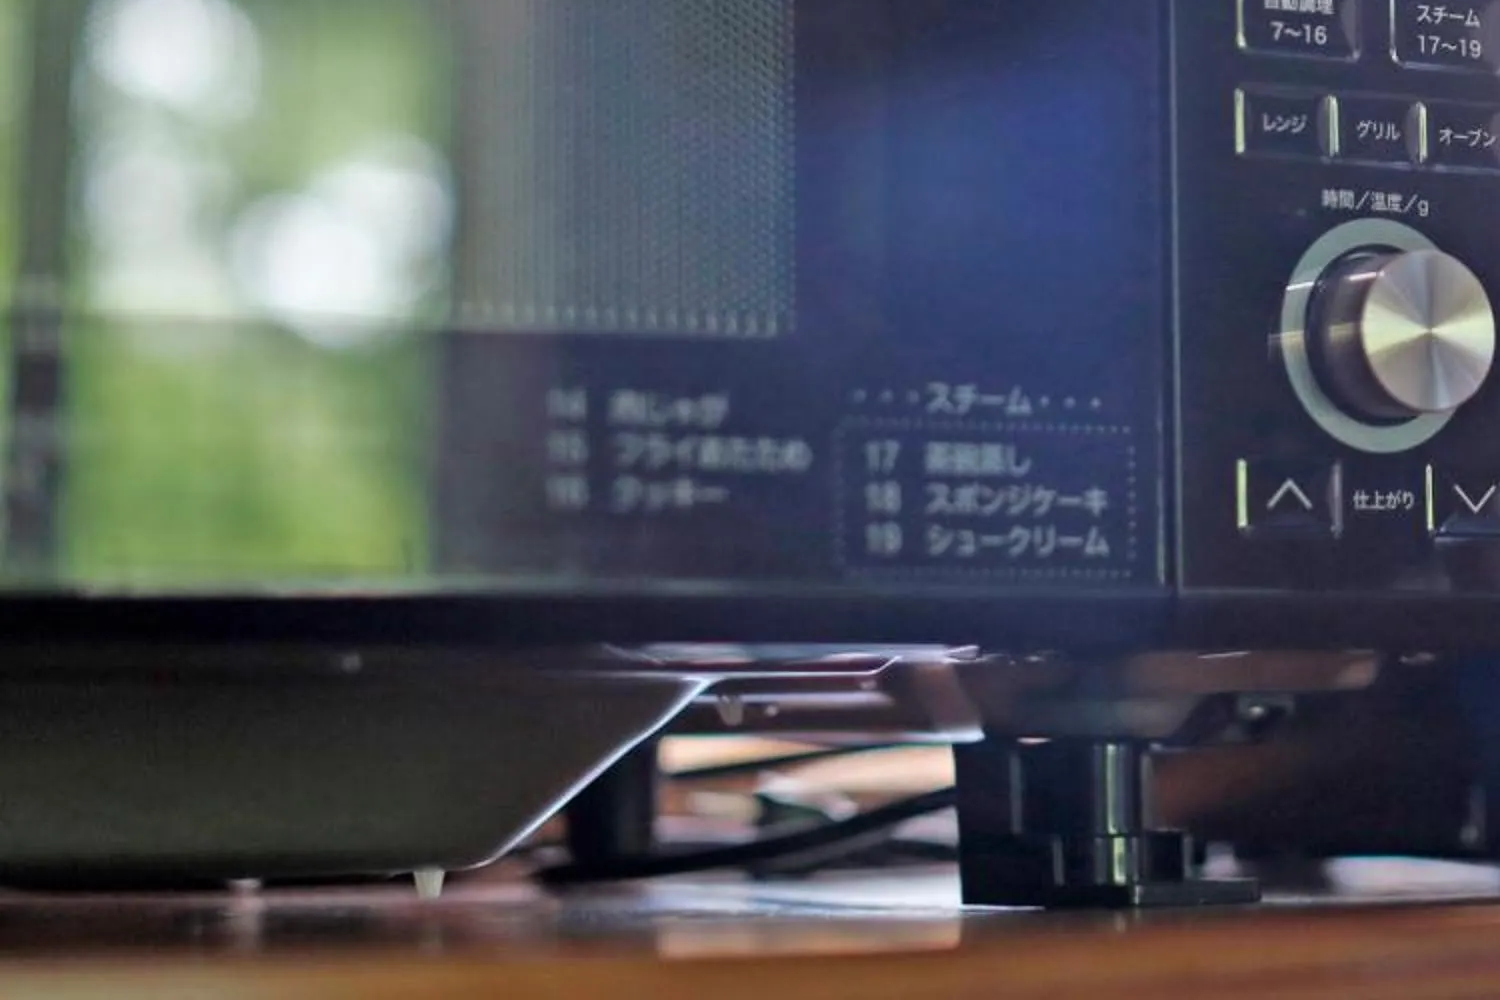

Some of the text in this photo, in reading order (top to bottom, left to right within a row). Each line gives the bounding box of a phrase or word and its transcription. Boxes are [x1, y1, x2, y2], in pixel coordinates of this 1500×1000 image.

[1417, 4, 1480, 28] スチーム
[1262, 113, 1307, 133] レンジ
[1356, 120, 1401, 141] グリル
[1439, 128, 1497, 147] オーブン
[1353, 489, 1415, 510] 仕上がり
